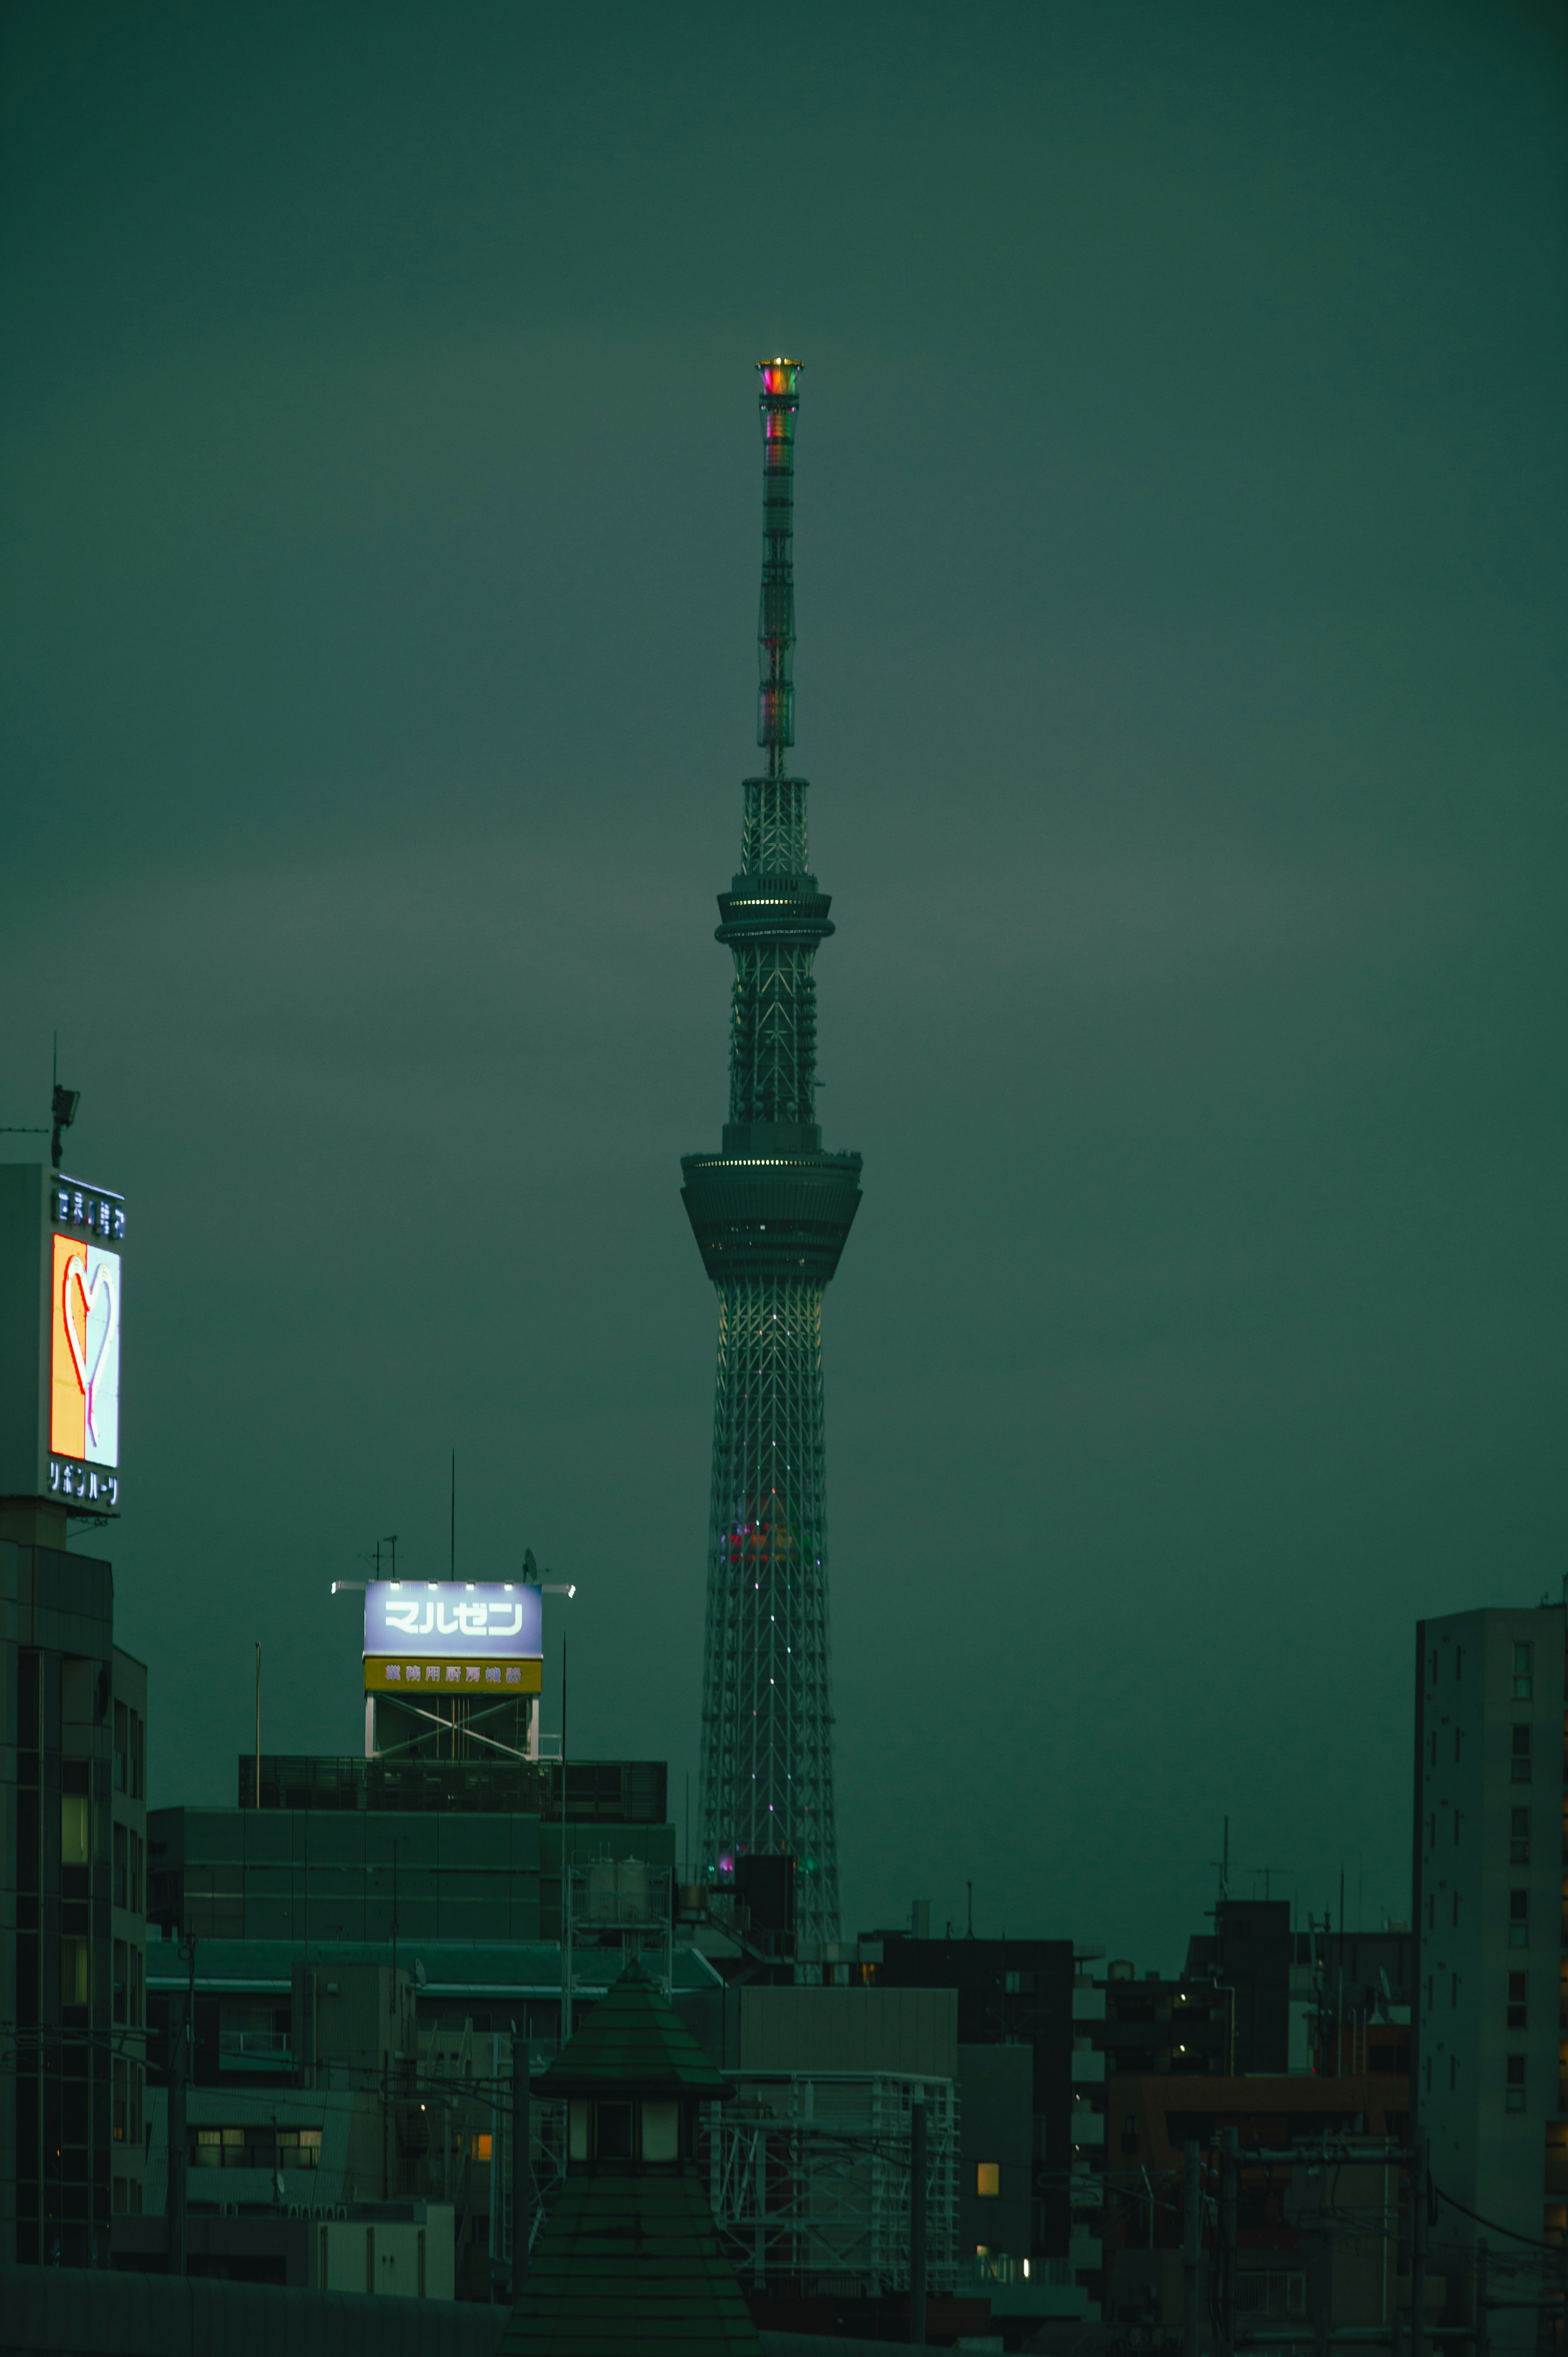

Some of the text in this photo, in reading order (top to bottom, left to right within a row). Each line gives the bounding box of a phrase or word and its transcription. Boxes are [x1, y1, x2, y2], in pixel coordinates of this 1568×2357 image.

[51, 1461, 117, 1505] リボンハーツ
[385, 1601, 522, 1636] マルゼン
[385, 1665, 521, 1684] 業務用厨房機器
